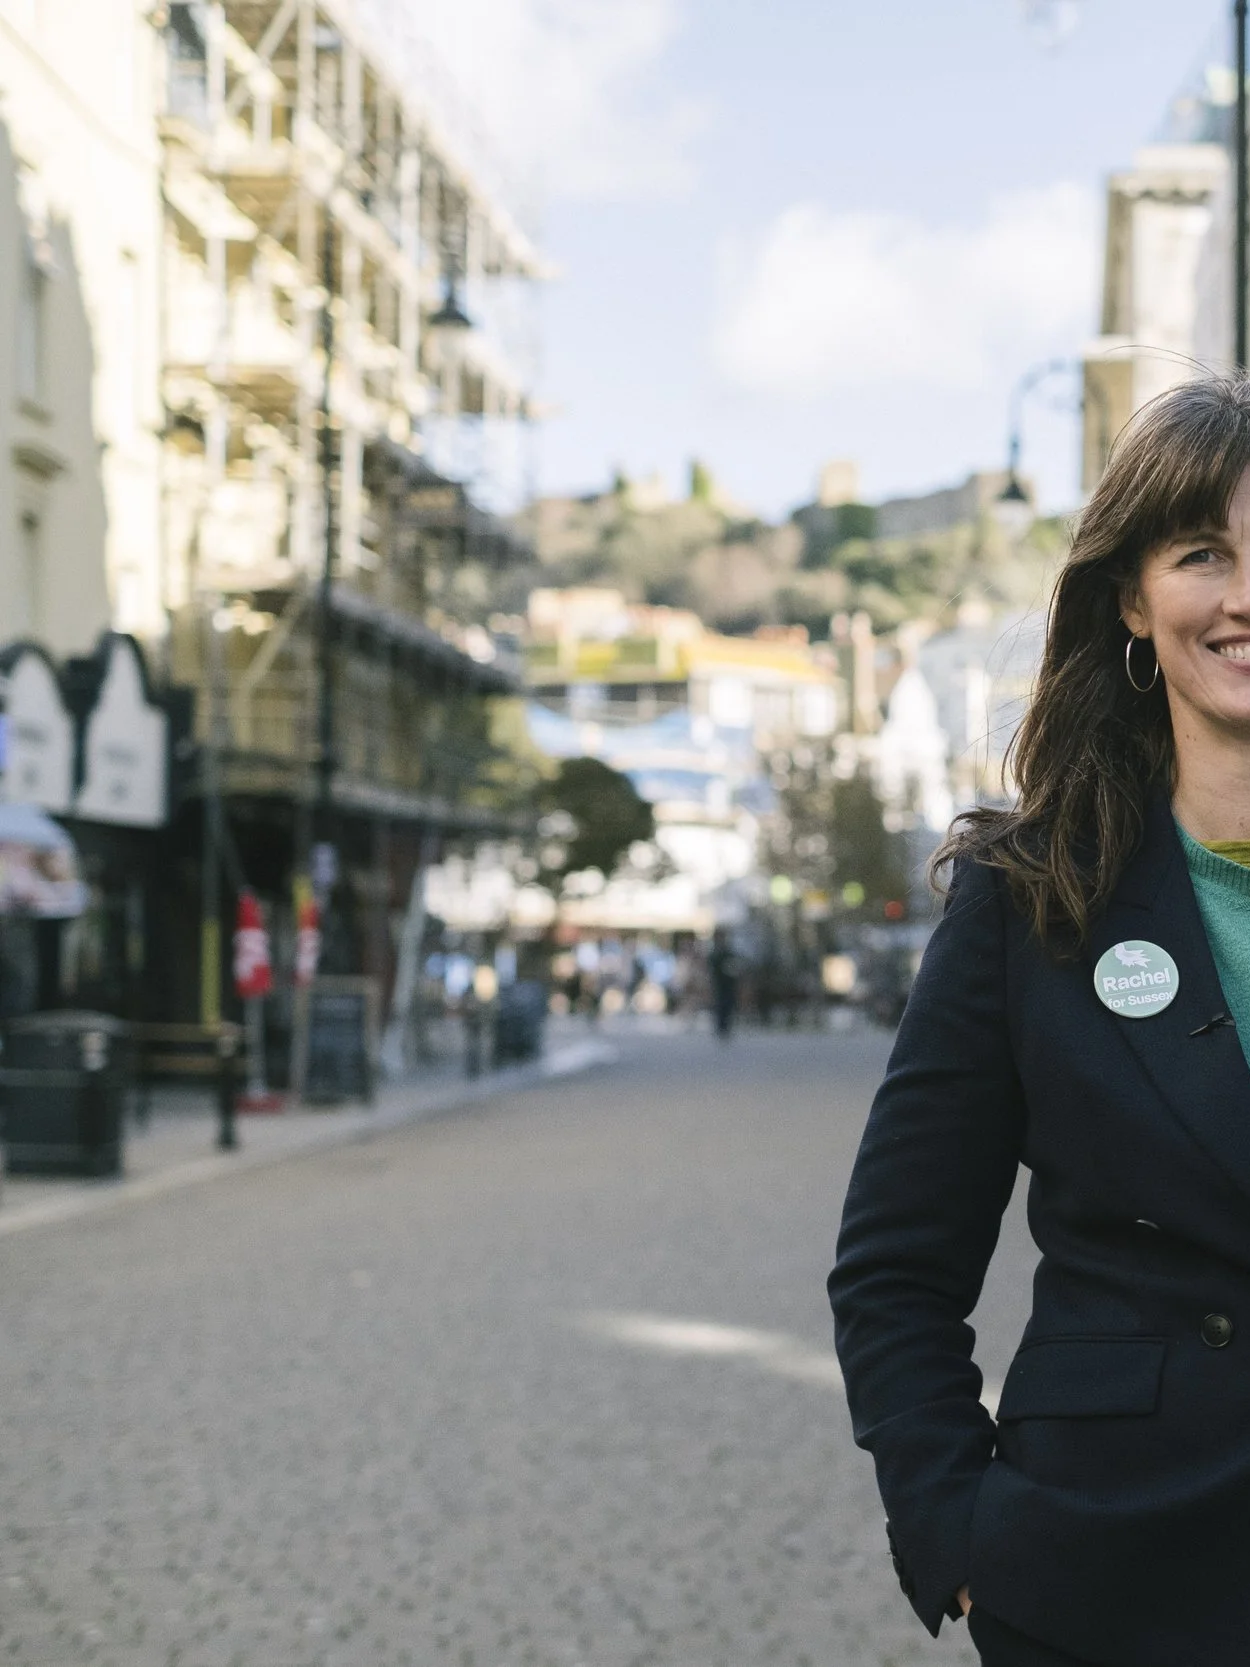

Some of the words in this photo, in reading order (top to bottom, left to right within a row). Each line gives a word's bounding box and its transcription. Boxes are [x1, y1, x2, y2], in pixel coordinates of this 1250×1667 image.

[1102, 967, 1171, 993] Rachel
[1107, 998, 1126, 1010] for
[1127, 991, 1174, 1006] Sussex
